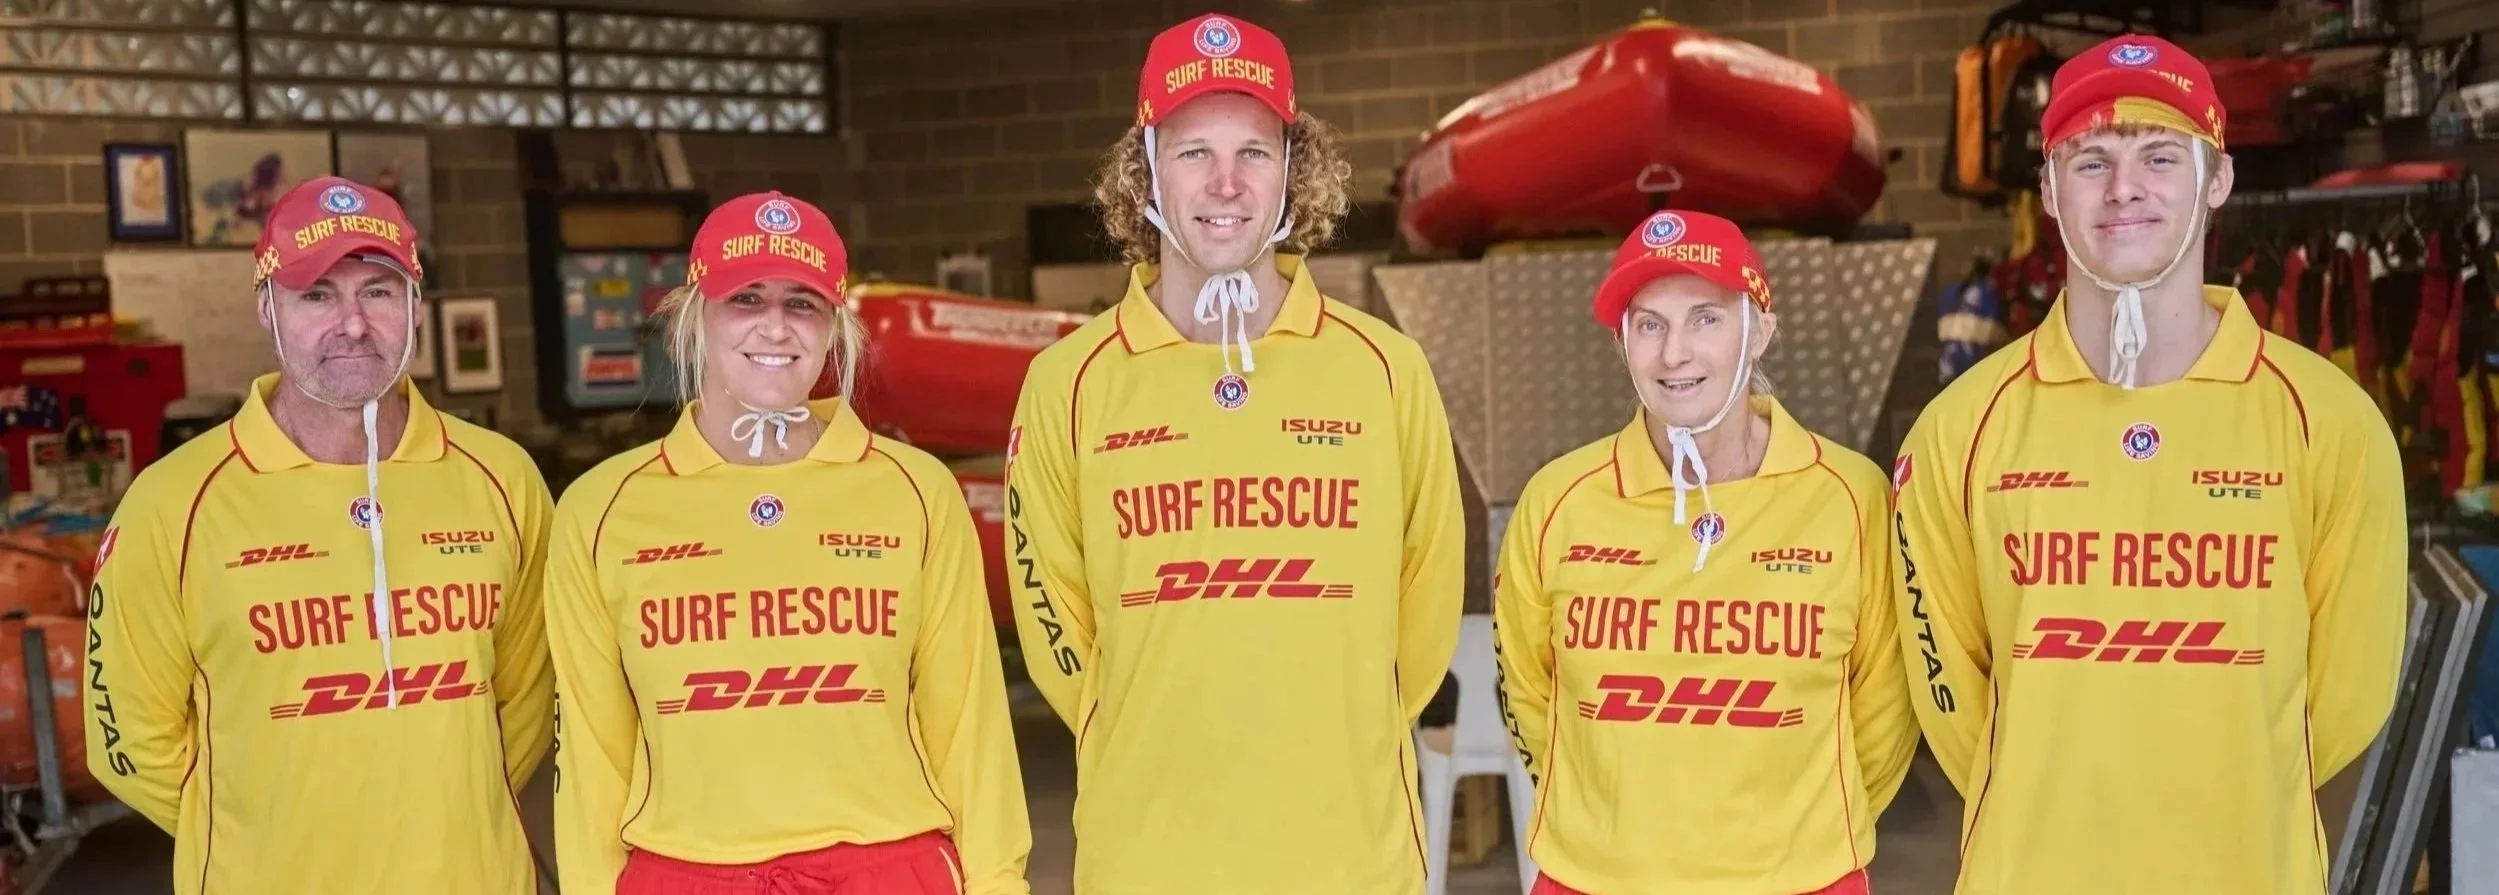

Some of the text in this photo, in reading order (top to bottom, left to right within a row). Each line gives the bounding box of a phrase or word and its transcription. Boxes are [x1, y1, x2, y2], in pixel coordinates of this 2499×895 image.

[1166, 58, 1276, 95] SURF RESCUE
[294, 215, 401, 250] SURF RESCUE
[722, 234, 827, 273] SURF RESCUE
[1104, 425, 1175, 451] DHL
[1281, 418, 1363, 436] ISUZU
[1297, 435, 1345, 447] UTE
[1999, 471, 2074, 492] DHL
[2191, 470, 2284, 487] ISUZU
[2208, 487, 2262, 500] UTE
[1113, 477, 1360, 540] SURF RESCUE
[421, 530, 495, 545] ISUZU
[439, 544, 484, 555] UTE
[819, 533, 901, 549] ISUZU
[240, 543, 316, 566] DHL
[636, 542, 709, 564] DHL
[835, 548, 883, 559] UTE
[1567, 545, 1644, 566] DHL
[1751, 547, 1834, 564] ISUZU
[2003, 531, 2279, 589] SURF RESCUE
[1009, 483, 1083, 677] QANTAS
[1154, 558, 1326, 604] DHL
[1765, 563, 1813, 575] UTE
[249, 595, 354, 654] SURF
[640, 586, 899, 650] SURF RESCUE
[1564, 595, 1826, 660] SURF RESCUE
[2028, 617, 2240, 664] DHL
[88, 582, 137, 777] QANTAS
[301, 659, 476, 717] DHL
[683, 664, 869, 713] DHL
[1595, 674, 1785, 729] DHL
